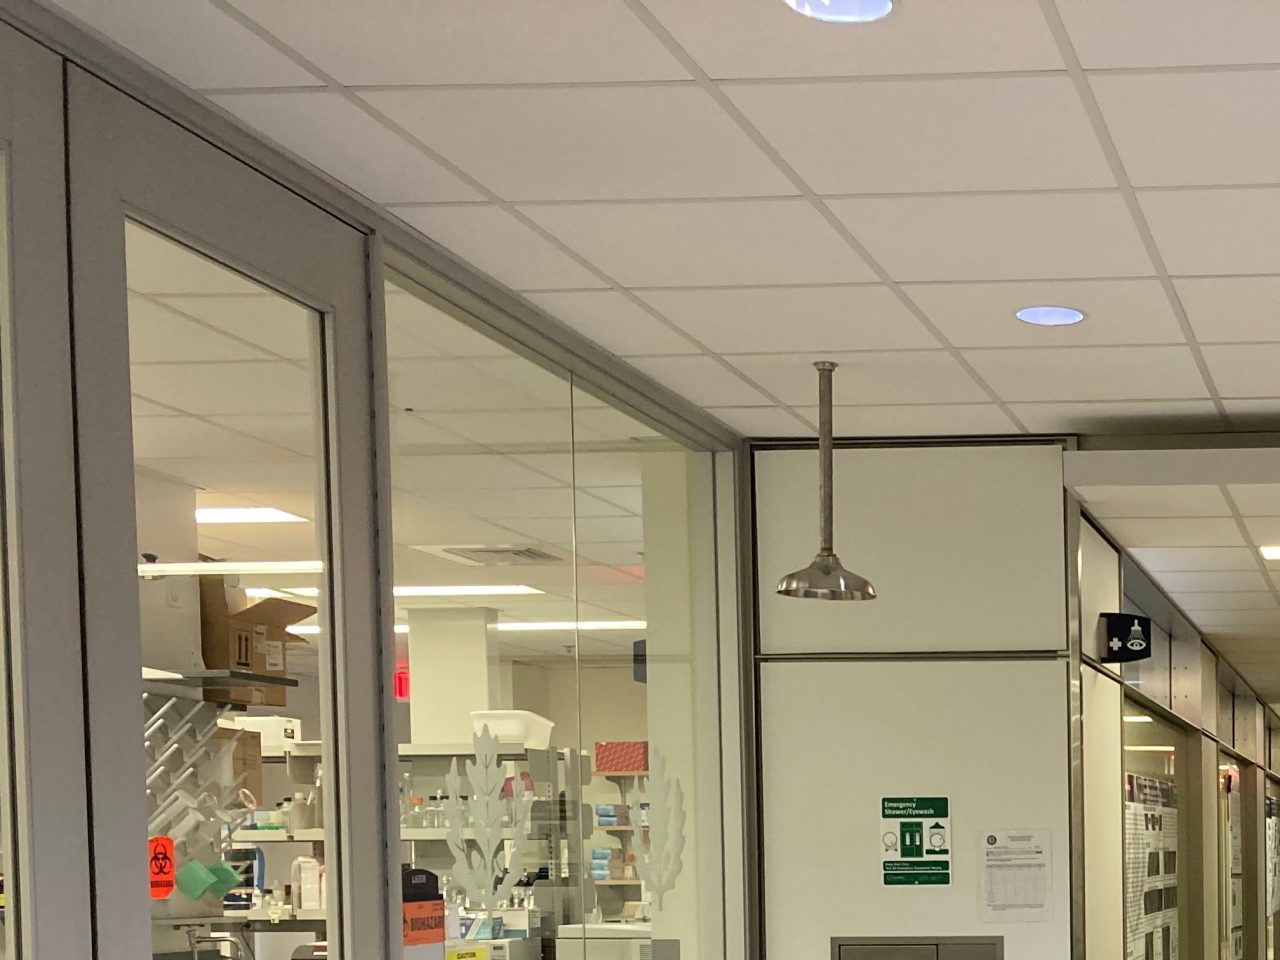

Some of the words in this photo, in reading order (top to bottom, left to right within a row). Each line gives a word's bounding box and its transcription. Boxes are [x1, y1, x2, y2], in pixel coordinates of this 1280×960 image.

[884, 801, 917, 809] Emergency
[884, 808, 935, 816] Shower/Eyewash
[457, 951, 476, 960] CAUTION
